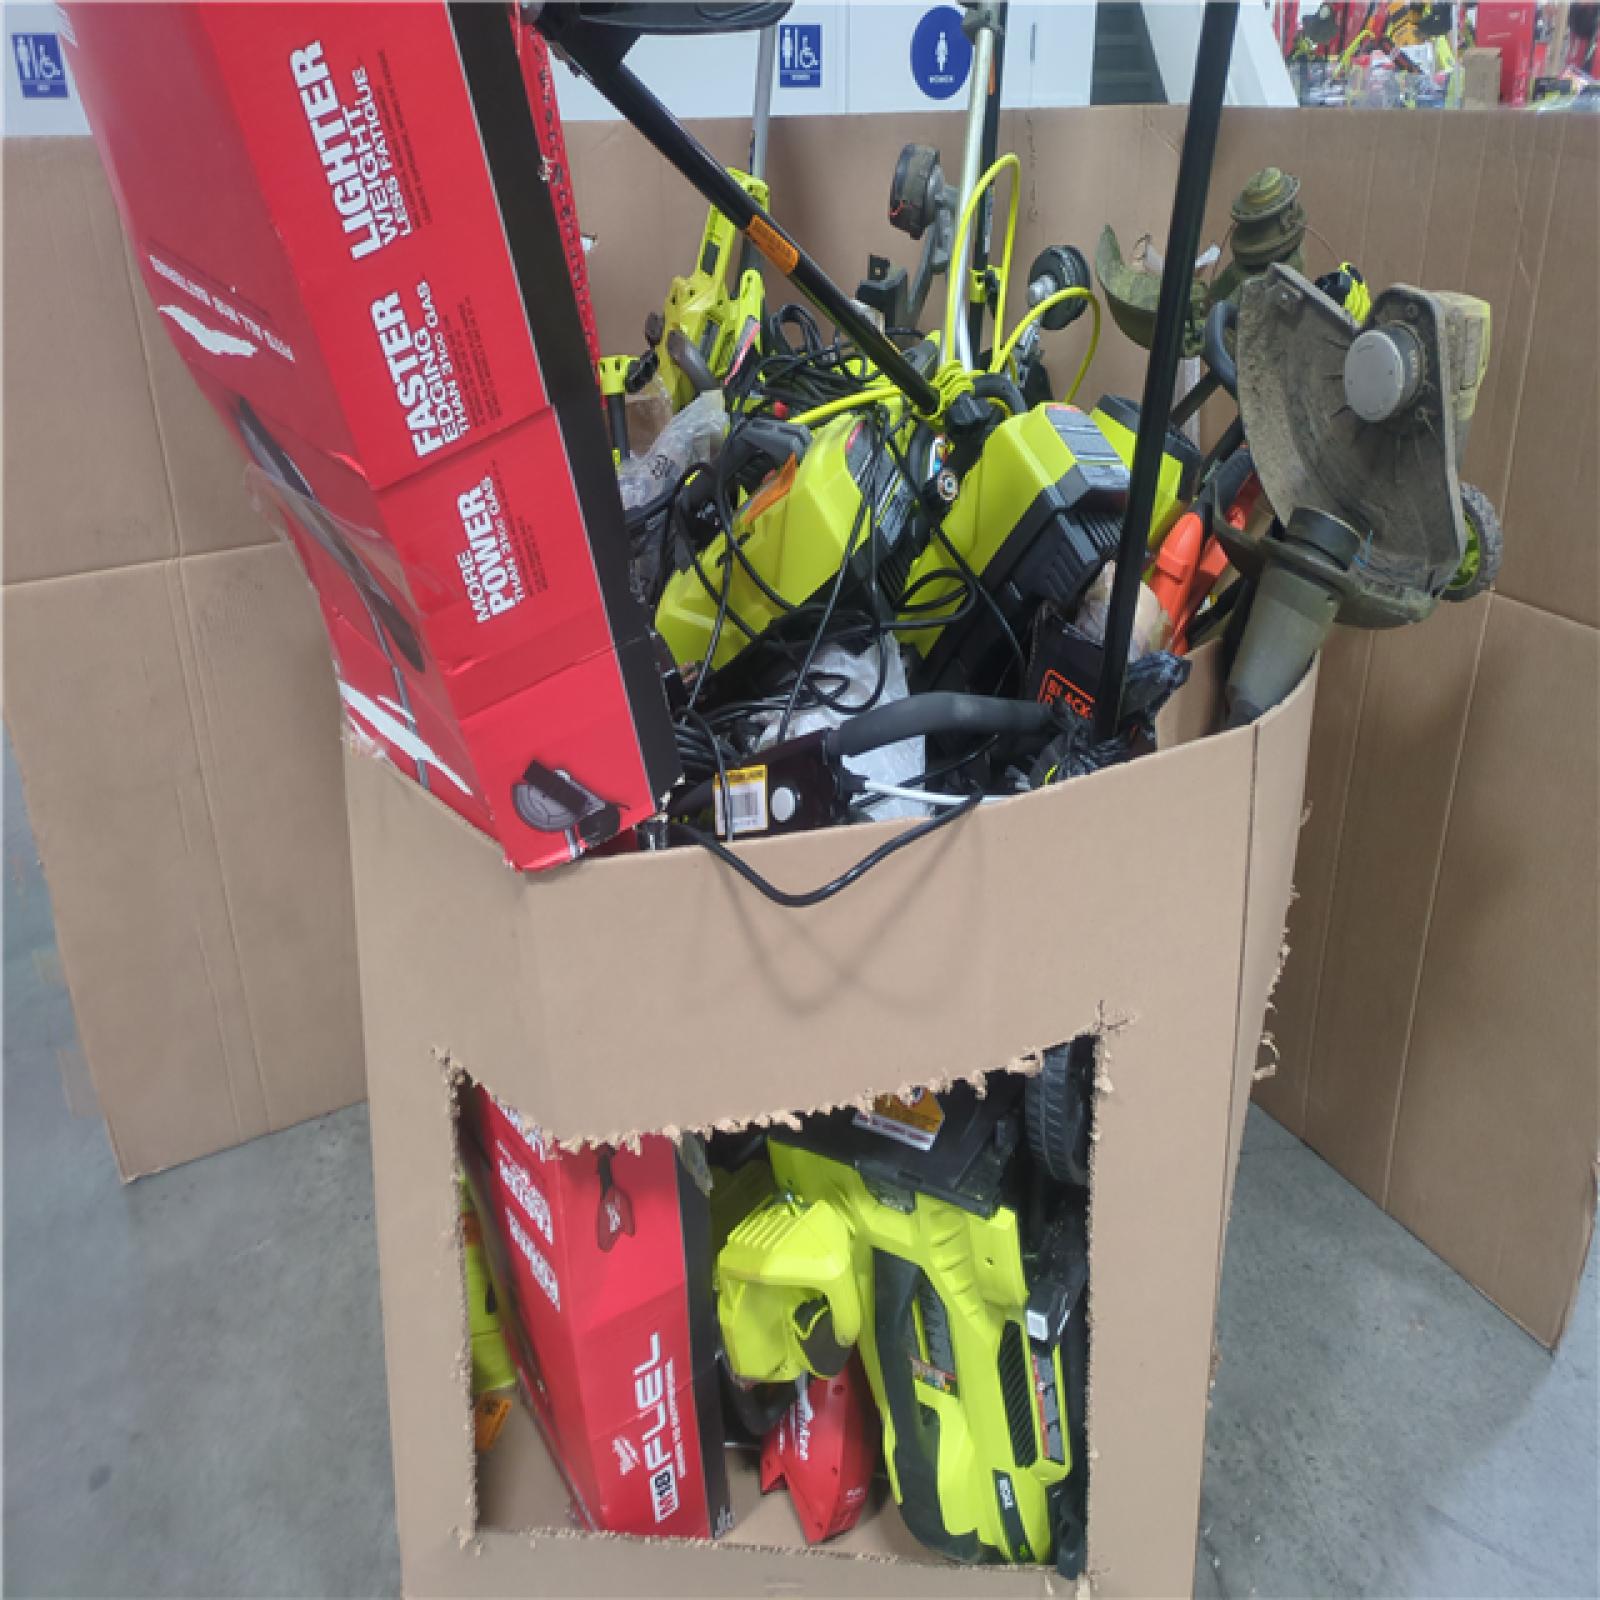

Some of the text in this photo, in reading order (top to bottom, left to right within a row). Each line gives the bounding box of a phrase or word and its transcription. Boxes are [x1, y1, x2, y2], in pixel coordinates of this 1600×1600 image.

[289, 39, 383, 261] LIGHTER
[341, 104, 398, 246] WEIGHT
[352, 64, 393, 171] FATIGUE
[416, 280, 439, 329] GAS
[370, 290, 444, 458] FASTER
[414, 326, 461, 443] EDGING
[455, 549, 491, 624] MORE
[456, 483, 518, 616] POWER
[632, 1331, 673, 1471] FUEL
